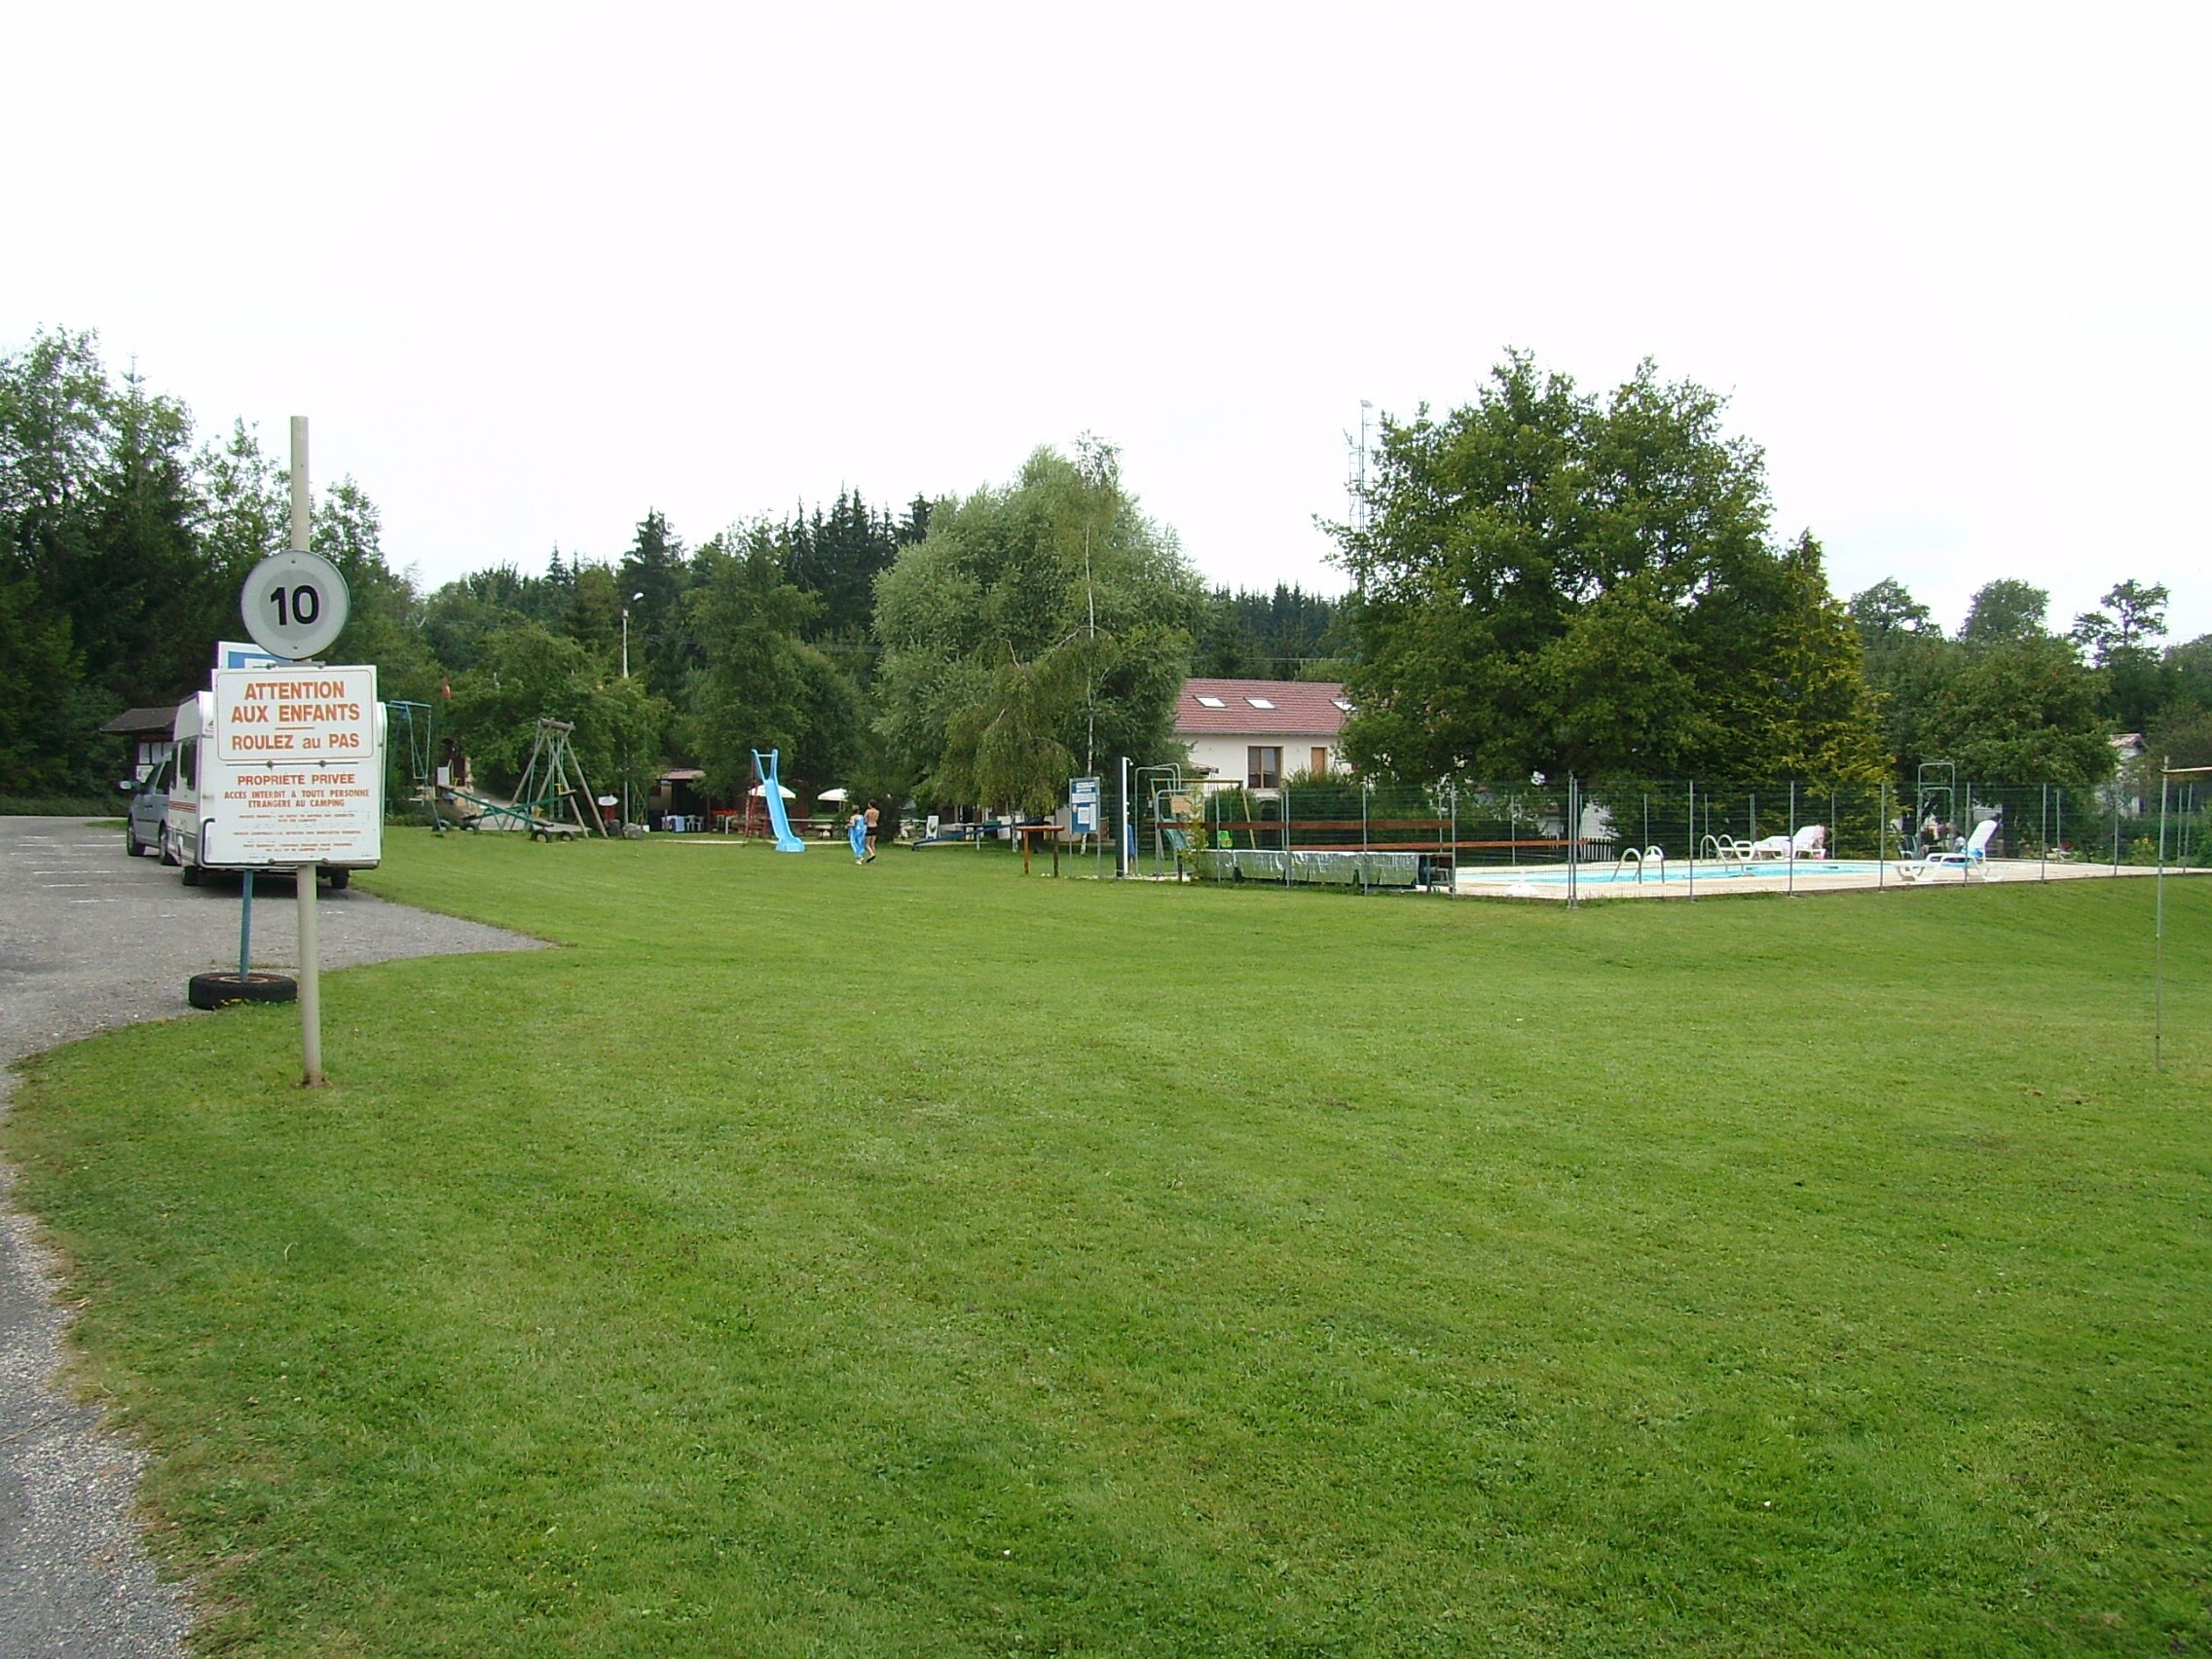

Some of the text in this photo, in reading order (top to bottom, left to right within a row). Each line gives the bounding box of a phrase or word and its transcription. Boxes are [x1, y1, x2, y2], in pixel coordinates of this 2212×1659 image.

[270, 585, 319, 626] 10
[244, 681, 345, 700] ATTENTION
[231, 703, 360, 723] AUX ENFANTS
[232, 733, 359, 751] ROULEZ au PAS
[251, 790, 286, 799] INTERDIT
[302, 790, 324, 798] TOUTE
[330, 789, 370, 797] PERSONNE
[311, 798, 345, 807] CAMPING
